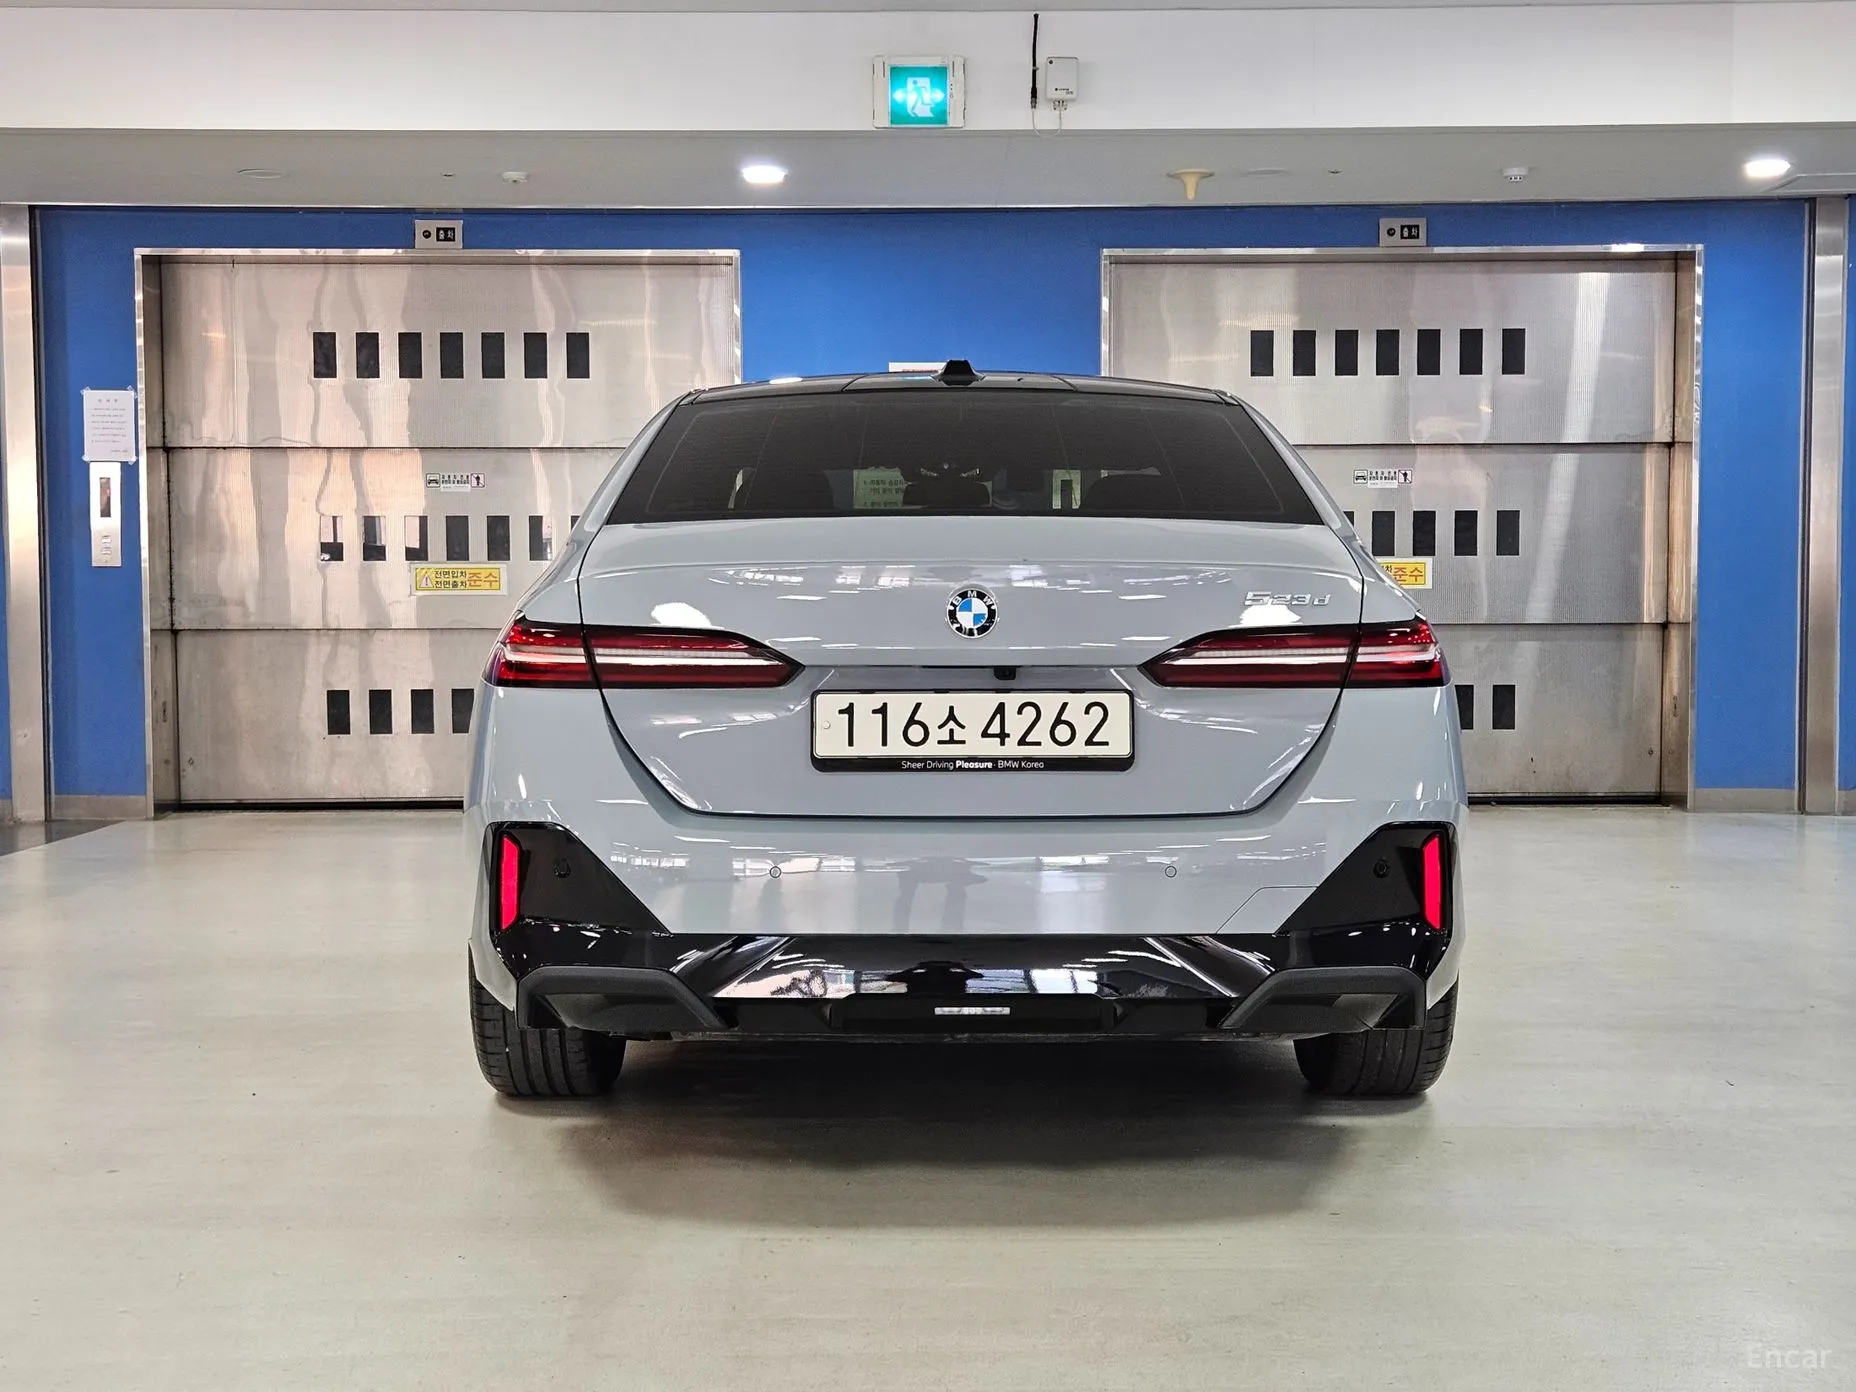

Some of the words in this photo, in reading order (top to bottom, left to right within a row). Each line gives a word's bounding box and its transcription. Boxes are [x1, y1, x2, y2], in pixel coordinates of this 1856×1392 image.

[434, 570, 467, 579] 전면입차
[467, 571, 499, 588] 준수
[1393, 567, 1424, 582] 준수
[434, 580, 467, 589] 전면출차
[1244, 591, 1331, 606] 523d
[838, 702, 966, 747] 116소
[980, 702, 1110, 747] 4262
[901, 760, 924, 769] Sheer
[926, 760, 954, 771] Driving
[955, 760, 993, 769] Pleasure
[998, 760, 1020, 769] BMW
[1021, 760, 1045, 769] Korea
